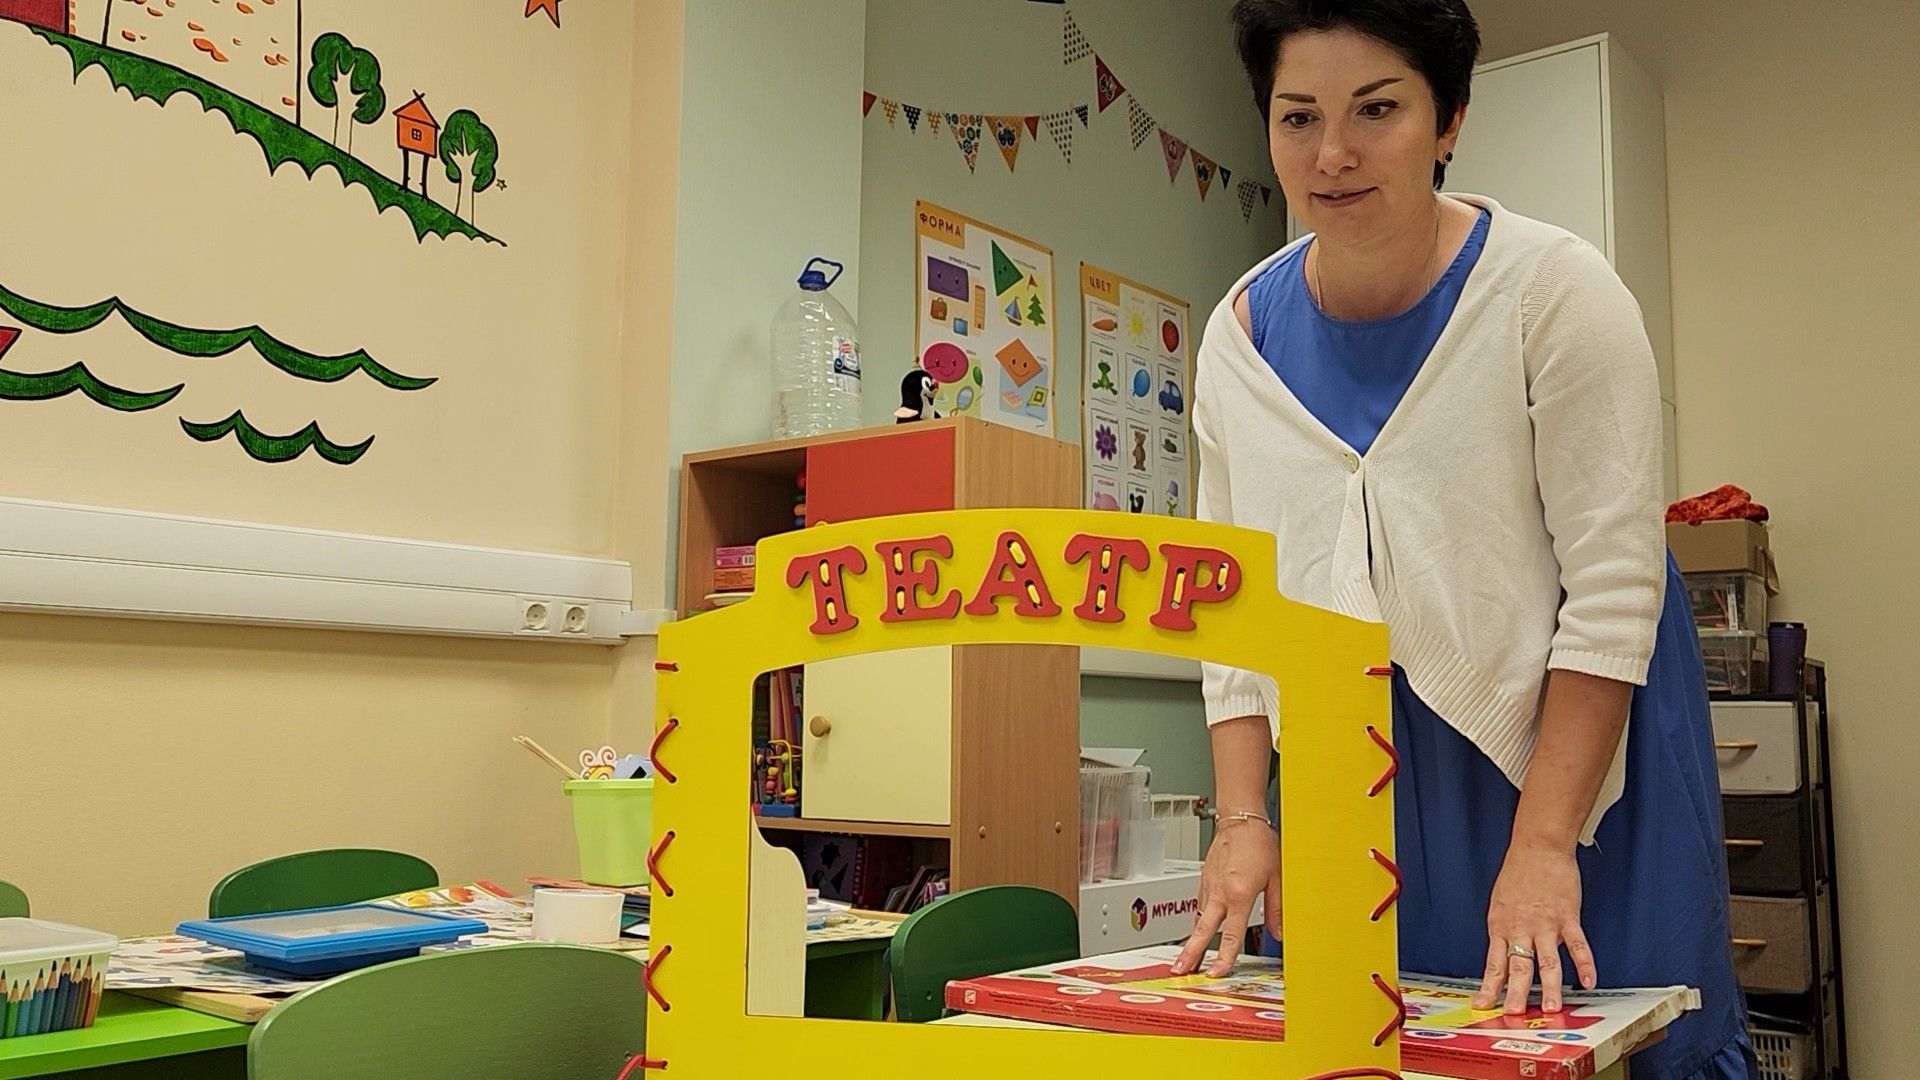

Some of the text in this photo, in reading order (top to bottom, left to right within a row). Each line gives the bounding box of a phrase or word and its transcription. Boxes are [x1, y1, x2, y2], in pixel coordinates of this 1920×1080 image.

[919, 212, 961, 237] ФОРМА
[1089, 275, 1112, 294] ЦВЕТ
[785, 529, 1242, 635] ТЕАТР
